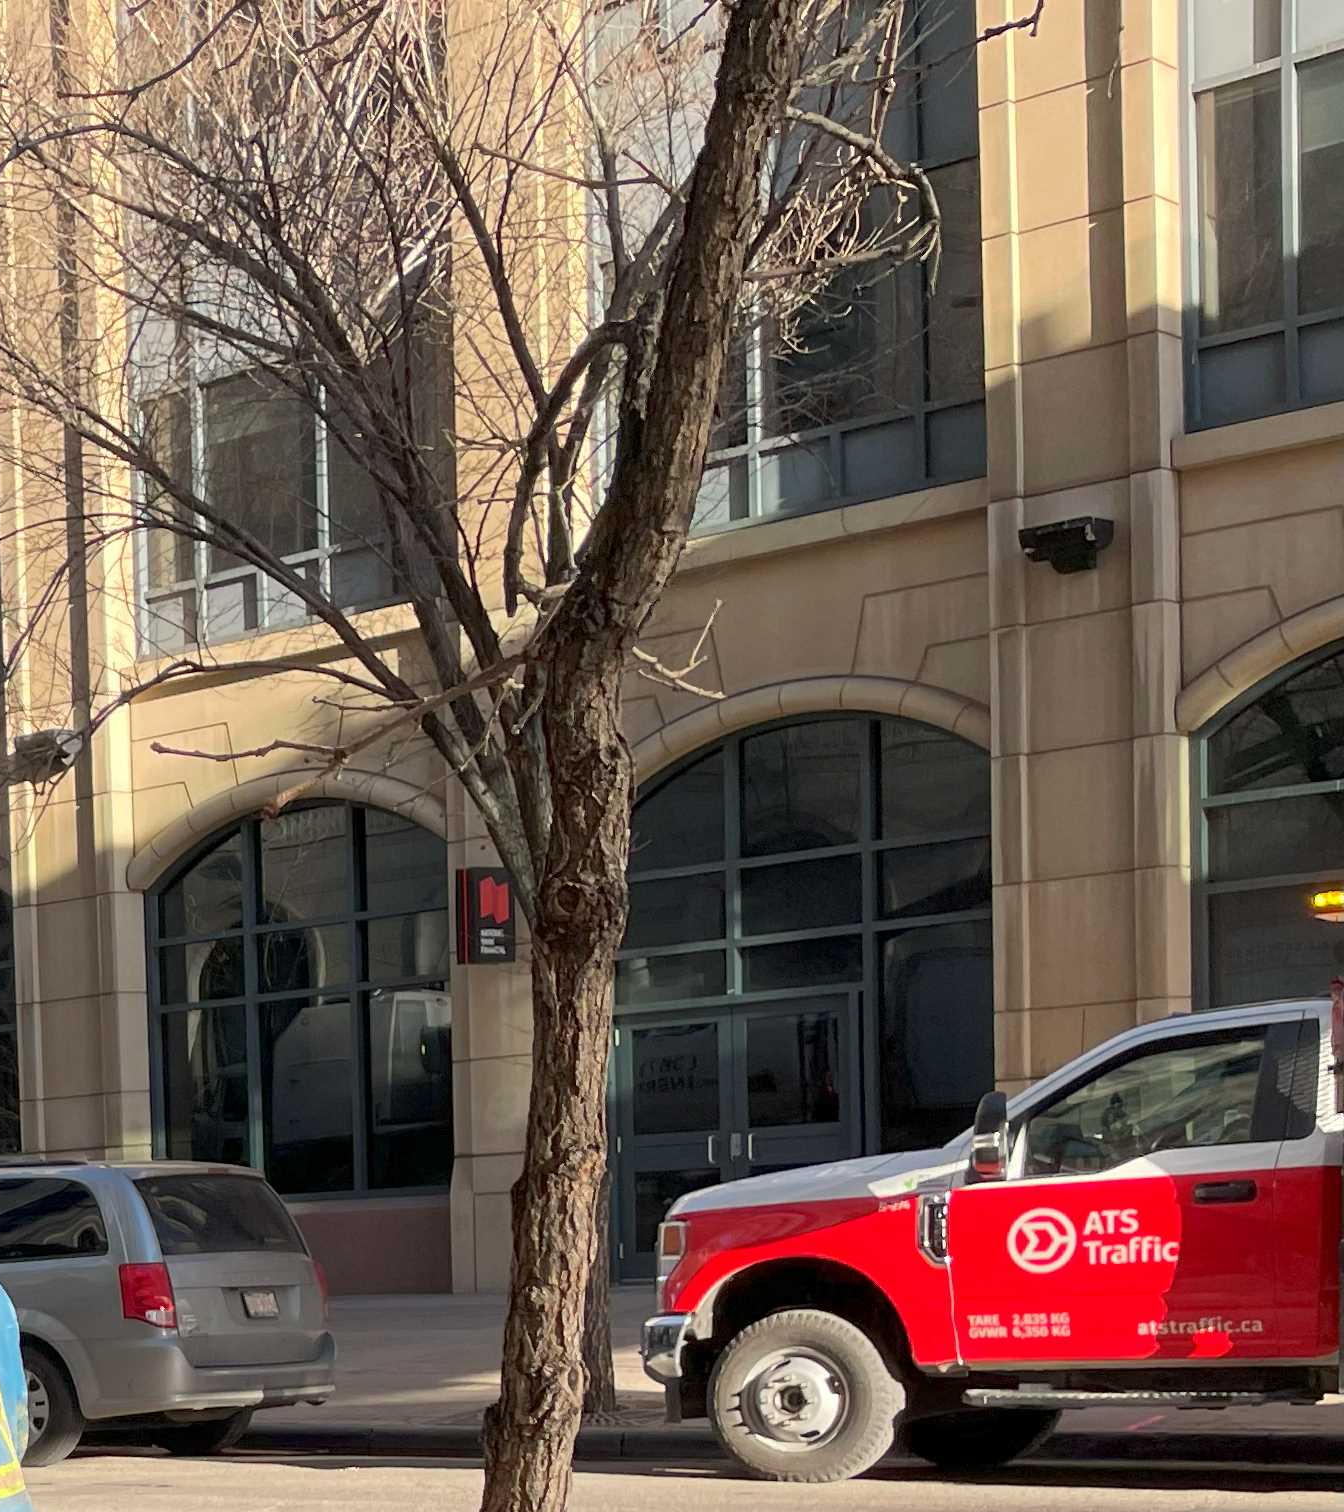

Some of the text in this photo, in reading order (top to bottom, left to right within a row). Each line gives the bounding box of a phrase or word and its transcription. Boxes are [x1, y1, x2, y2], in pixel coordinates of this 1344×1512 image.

[1083, 1208, 1140, 1236] ATS
[1083, 1236, 1179, 1265] Traffic
[967, 1314, 1000, 1326] TARE
[1050, 1312, 1070, 1325] KG
[1137, 1316, 1264, 1337] atstraffic.ca
[969, 1326, 1008, 1339] GVWR
[1051, 1325, 1071, 1337] KG
